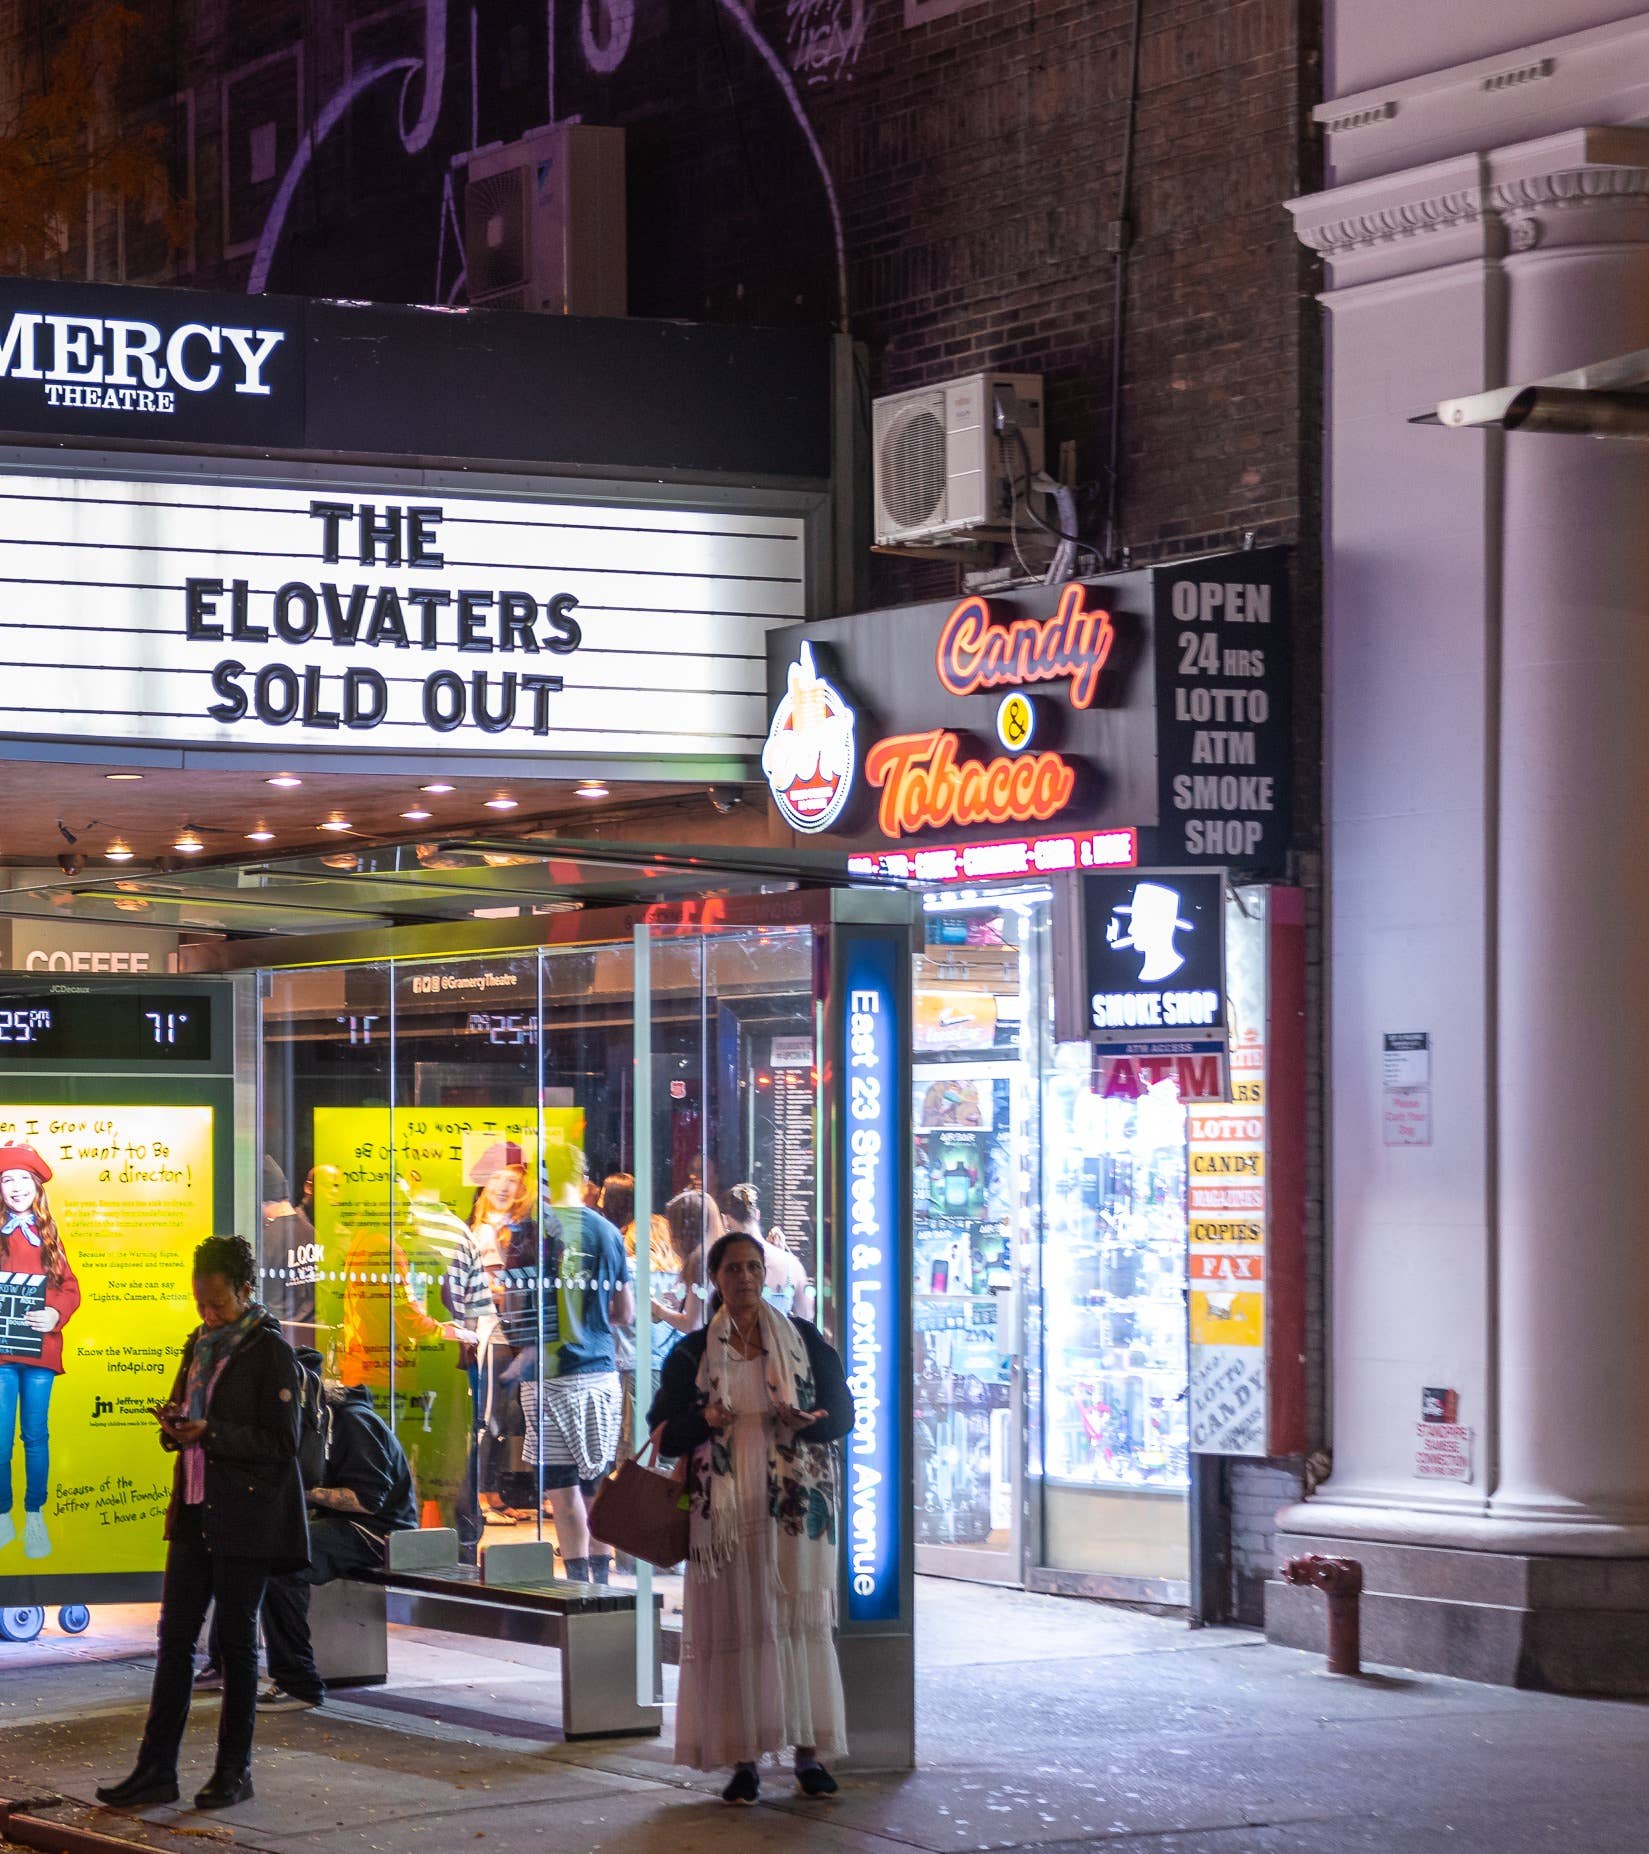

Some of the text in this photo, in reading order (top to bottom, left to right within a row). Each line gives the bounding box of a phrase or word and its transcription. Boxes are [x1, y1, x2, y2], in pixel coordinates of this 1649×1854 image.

[44, 383, 174, 413] THEATRE
[310, 500, 444, 569] THE
[185, 577, 582, 655] ELOVATERS
[1171, 581, 1271, 625] OPEN
[935, 582, 1113, 710] Candy
[1178, 631, 1265, 679] 24 HRS
[207, 658, 563, 736] SOLD OUT
[1175, 688, 1269, 724] LOTTO
[1007, 697, 1028, 740] &
[1192, 731, 1256, 766] ATM
[866, 727, 1076, 840] Tobacco
[1173, 775, 1274, 812] SMOKE
[1185, 820, 1263, 857] SHOP
[49, 985, 90, 994] JCDecaux
[441, 972, 518, 991] @GramercyTheatre
[1092, 991, 1219, 1027] SMOKE SHOP
[1104, 1056, 1220, 1099] ATM
[25, 1120, 39, 1135] I
[1191, 1120, 1263, 1139] LOTTO
[60, 1145, 73, 1160] I
[78, 1138, 120, 1160] want
[125, 1141, 146, 1159] to
[1194, 1156, 1260, 1175] CANDY
[99, 1160, 192, 1188] a director!
[1194, 1223, 1262, 1241] COPIES
[1201, 1257, 1252, 1278] FAX
[108, 1281, 126, 1289] Now
[129, 1281, 143, 1289] she
[161, 1283, 175, 1291] say
[846, 990, 882, 1597] East 23 Street & Lexington Avenue
[77, 1345, 185, 1357] Know the Warning Sign
[108, 1362, 165, 1374] info4pi.org
[1194, 1358, 1245, 1411] LOTTO
[91, 1395, 168, 1419] jm Jeffrey Mod
[119, 1405, 152, 1414] Founda
[1193, 1369, 1263, 1447] CANDY
[53, 1483, 172, 1517] Jeffrey Modell Foundati
[55, 1476, 134, 1499] Because of the
[100, 1506, 168, 1526] I have a Cha
